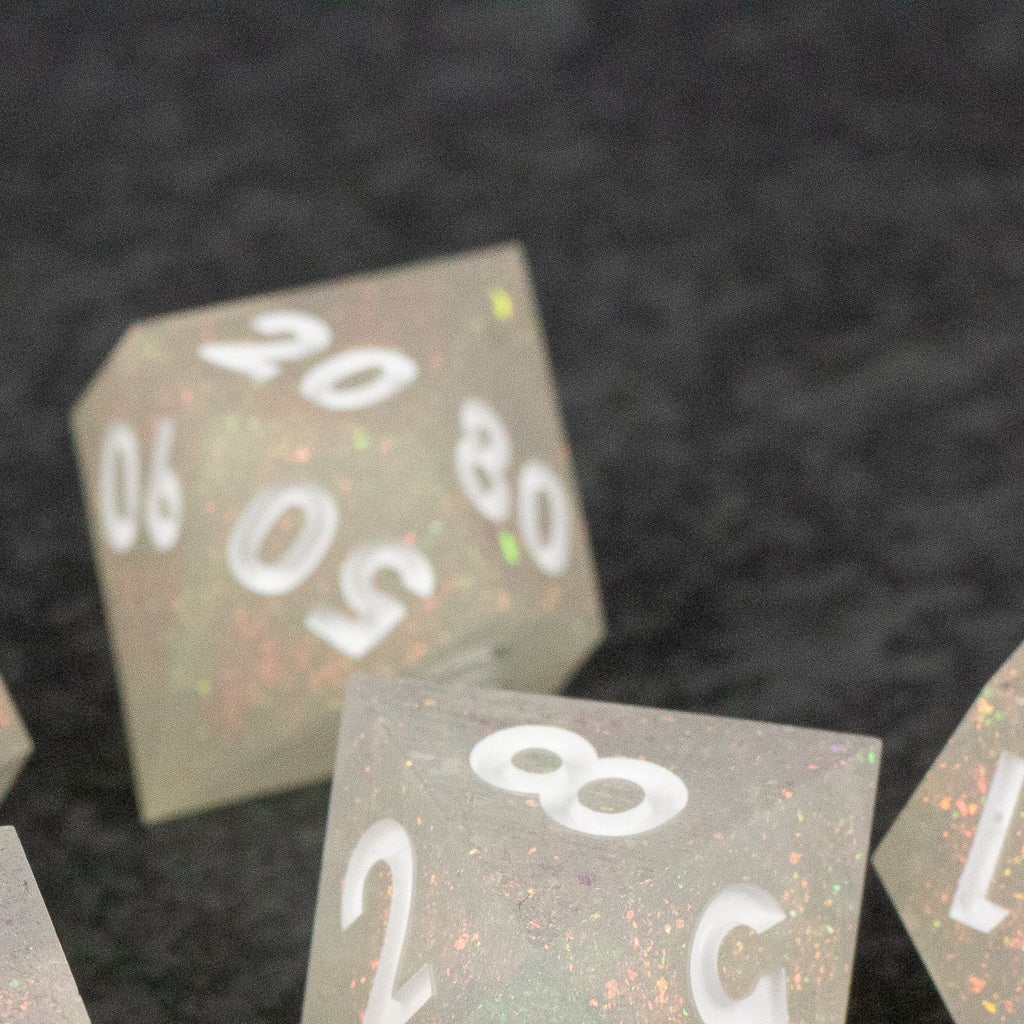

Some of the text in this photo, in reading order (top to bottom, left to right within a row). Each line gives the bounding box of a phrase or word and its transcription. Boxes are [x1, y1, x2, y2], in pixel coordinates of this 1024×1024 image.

[197, 311, 419, 411] 20
[454, 397, 568, 576] 80
[227, 484, 437, 660] 50
[469, 724, 689, 837] 8
